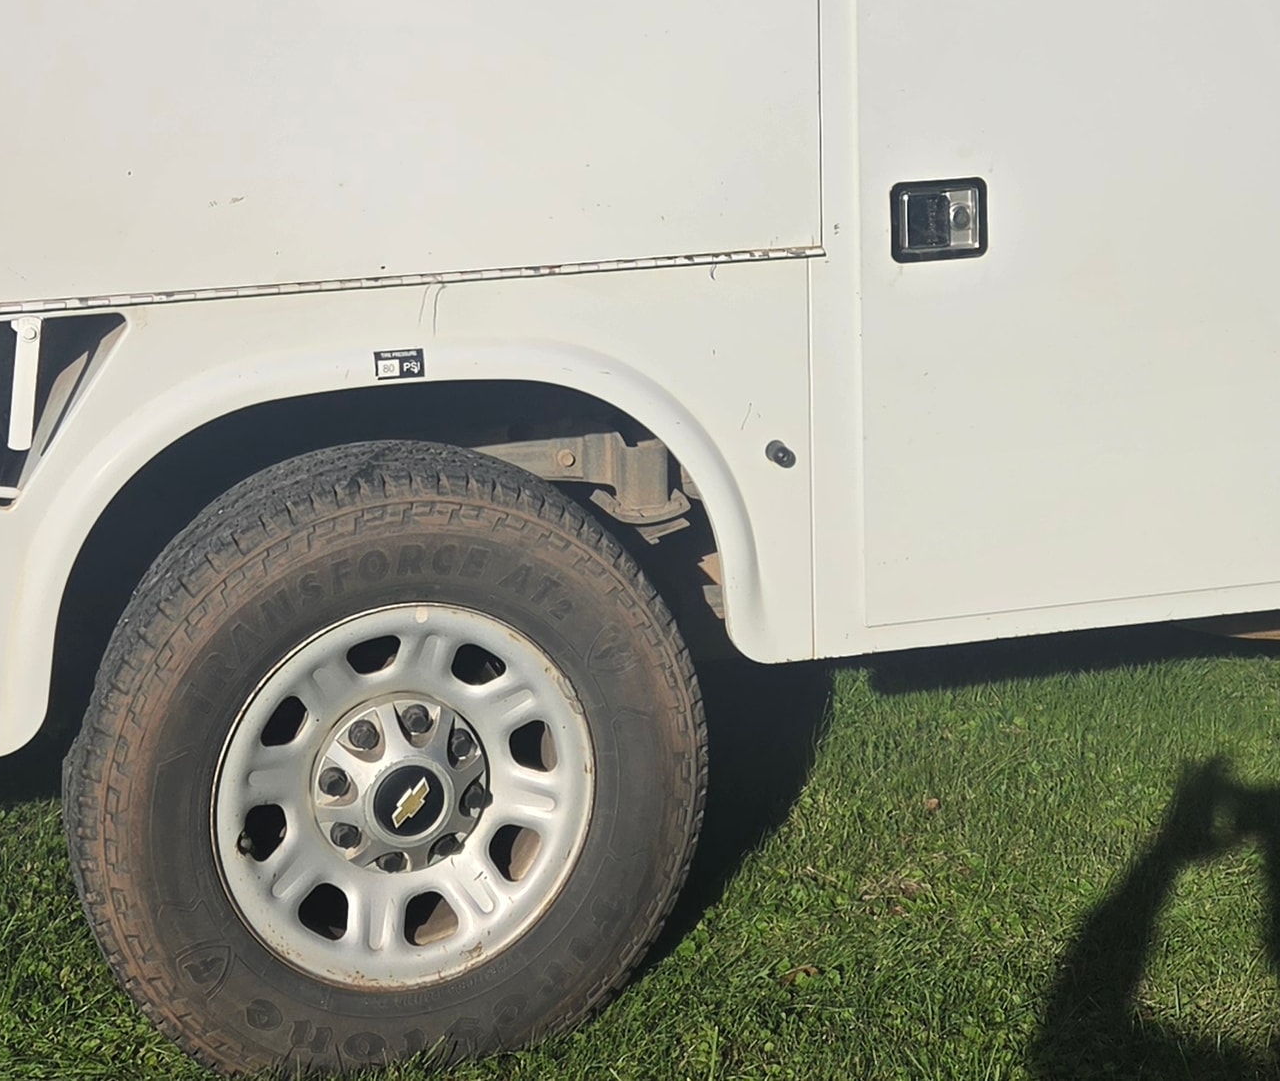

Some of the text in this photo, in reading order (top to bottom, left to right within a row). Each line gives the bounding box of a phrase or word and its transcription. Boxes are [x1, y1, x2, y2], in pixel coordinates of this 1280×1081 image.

[382, 363, 395, 374] 80
[403, 361, 421, 373] PSI
[177, 544, 573, 719] TRANSFORCE AT2
